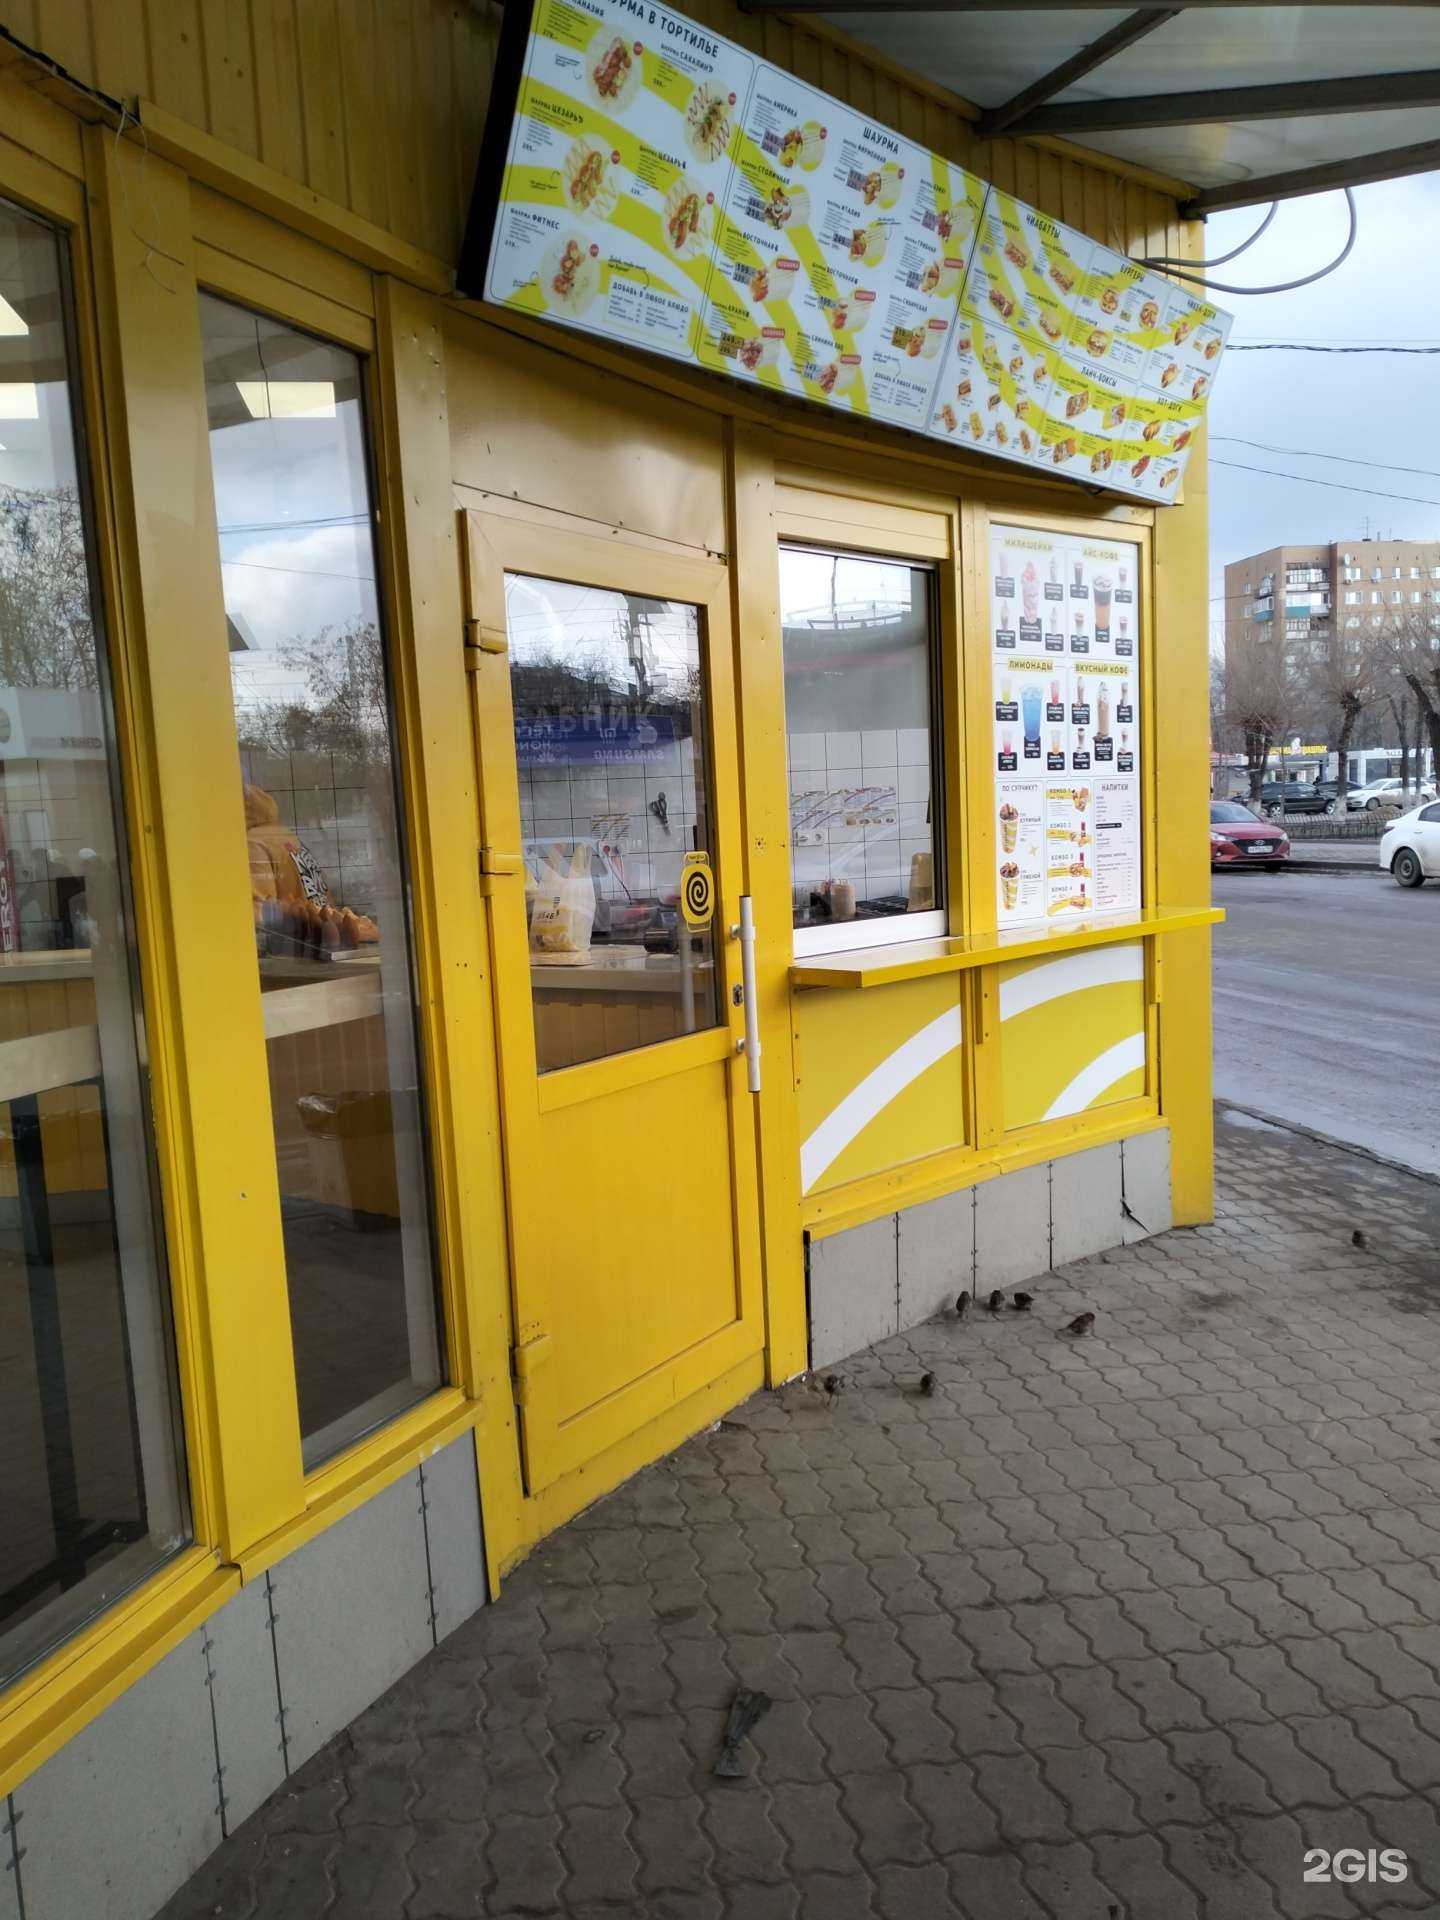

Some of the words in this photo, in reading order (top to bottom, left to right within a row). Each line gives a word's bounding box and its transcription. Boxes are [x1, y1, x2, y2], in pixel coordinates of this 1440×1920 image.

[648, 11, 657, 25] В
[660, 16, 719, 58] ТОРТИЛЬЕ
[863, 126, 900, 155] ШАУРМА
[1081, 366, 1118, 387] ЛАНЧ-БОКСЫ
[1009, 659, 1053, 671] ЛИМОНАДЫ
[1076, 663, 1109, 673] ВКУСНЫЙ
[1109, 664, 1129, 675] КОФЕ
[1101, 783, 1129, 792] НАПИТКИ
